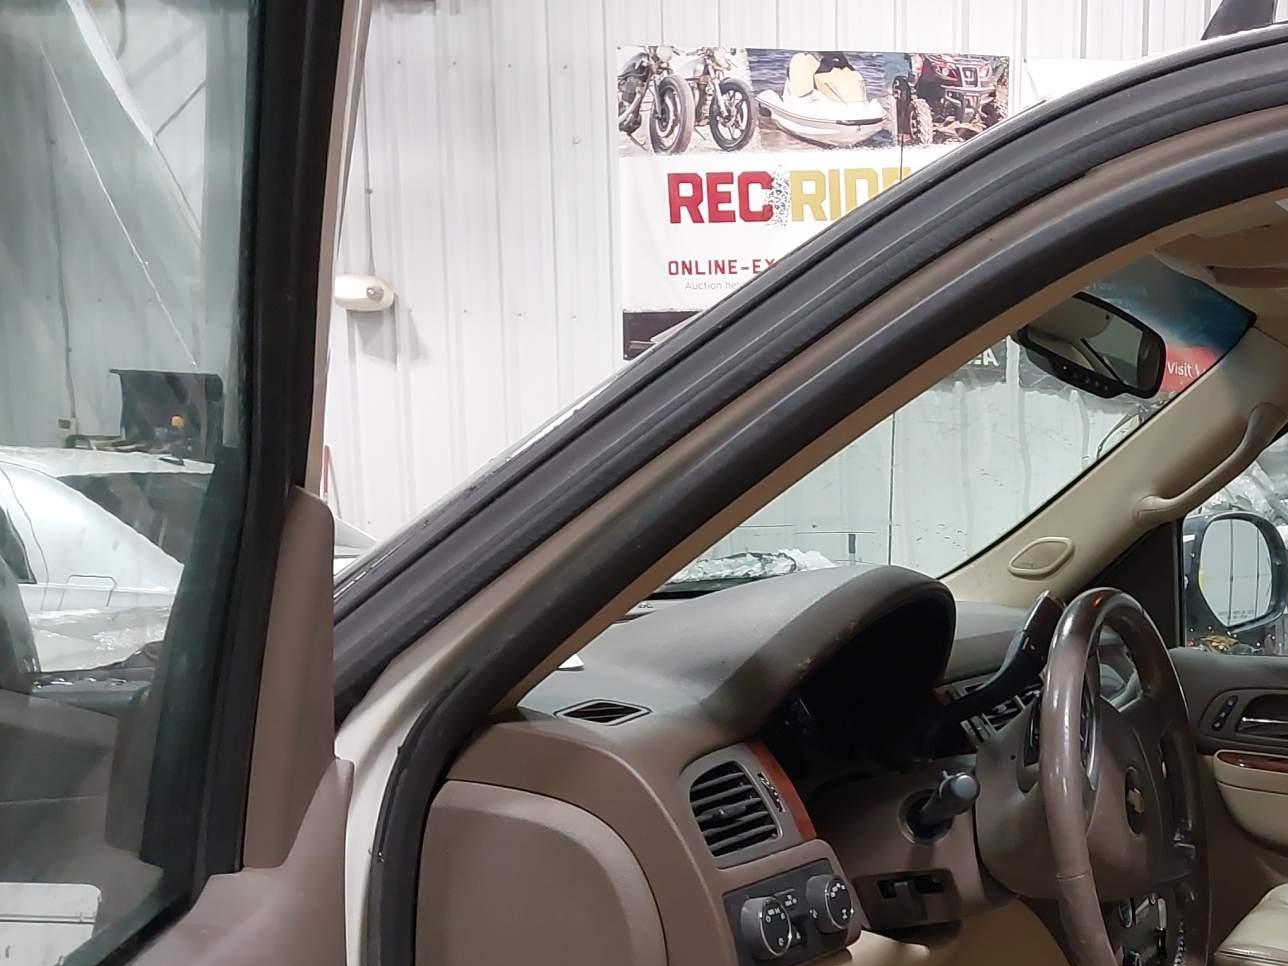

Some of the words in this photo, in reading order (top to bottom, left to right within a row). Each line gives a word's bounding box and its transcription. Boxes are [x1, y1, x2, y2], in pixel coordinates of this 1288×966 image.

[667, 171, 775, 223] REC
[685, 281, 723, 290] Auction
[1167, 361, 1193, 378] Visit
